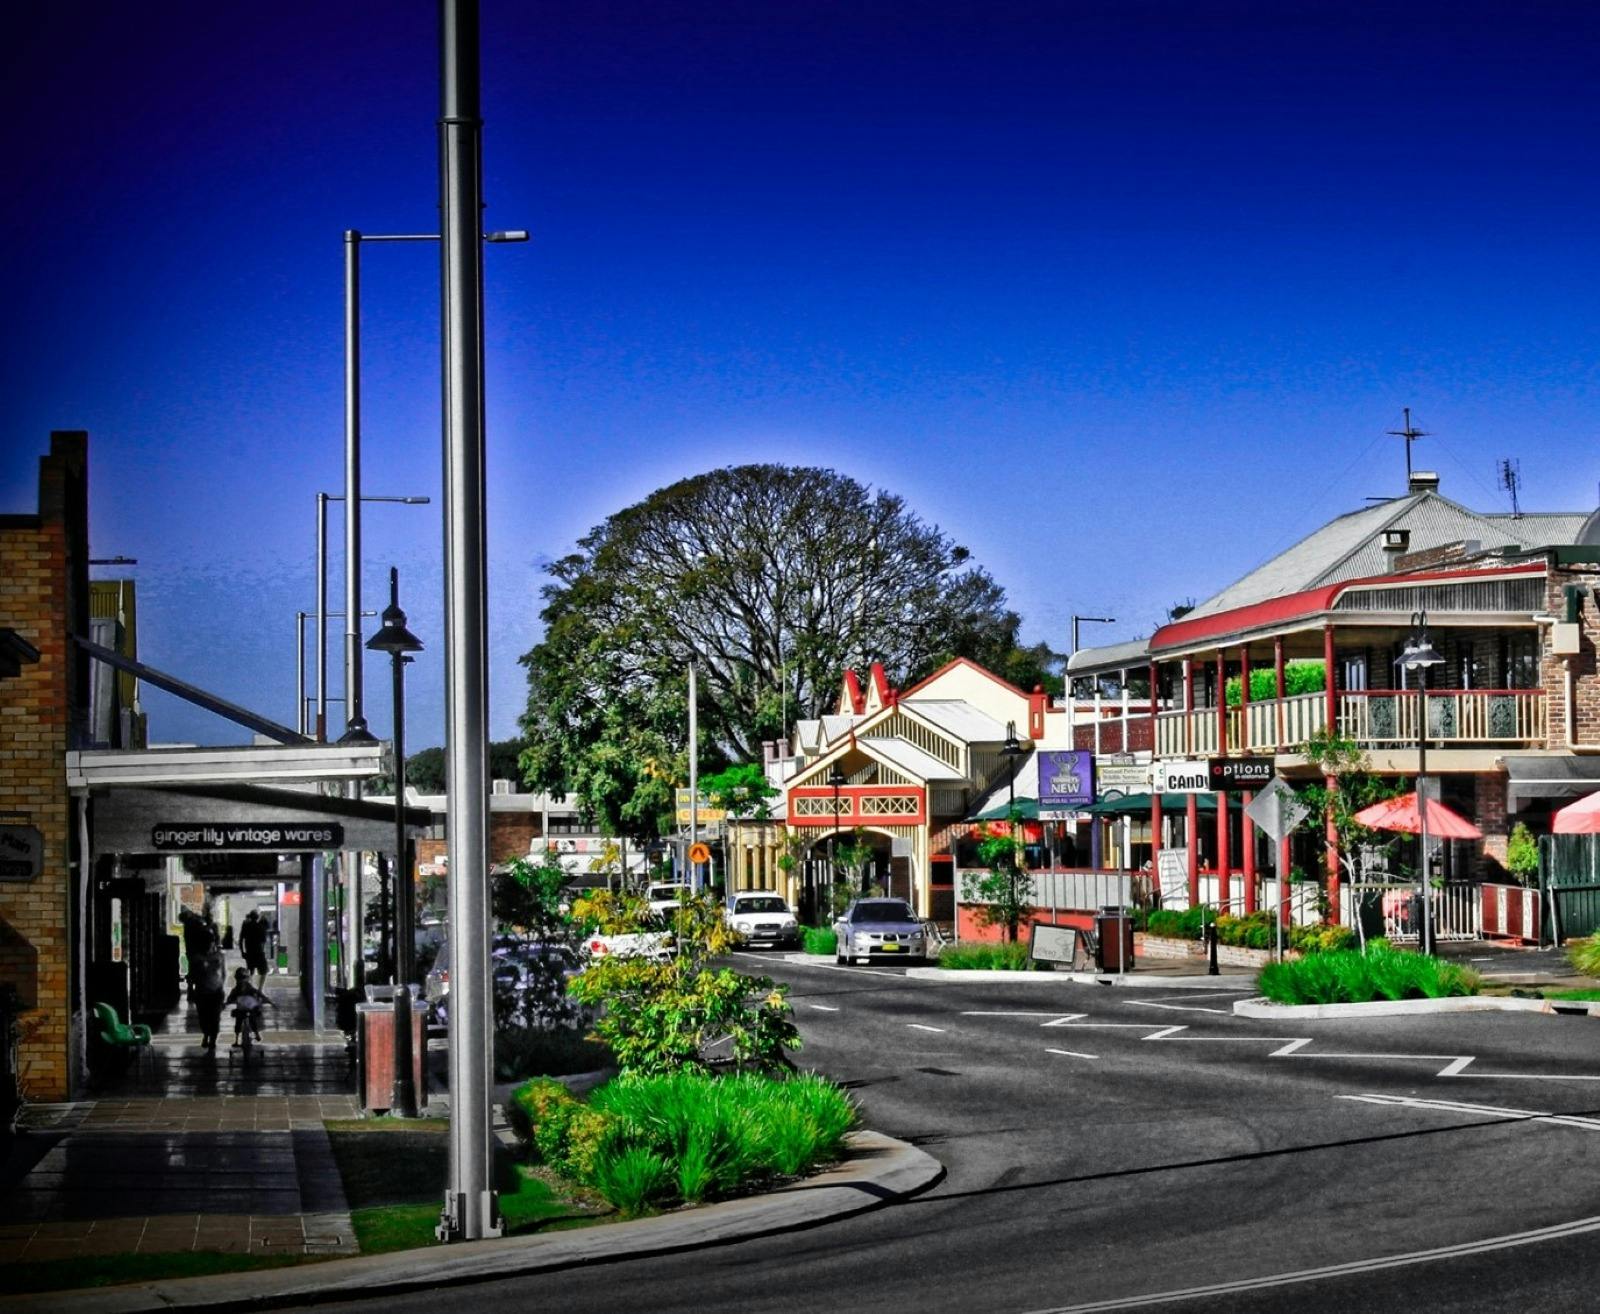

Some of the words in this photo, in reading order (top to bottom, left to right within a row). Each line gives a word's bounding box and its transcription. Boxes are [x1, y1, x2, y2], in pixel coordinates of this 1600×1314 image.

[1213, 763, 1270, 776] options
[1051, 783, 1080, 794] NEW
[154, 827, 224, 846] gingerlily
[227, 828, 281, 845] vintage
[284, 829, 332, 842] wares
